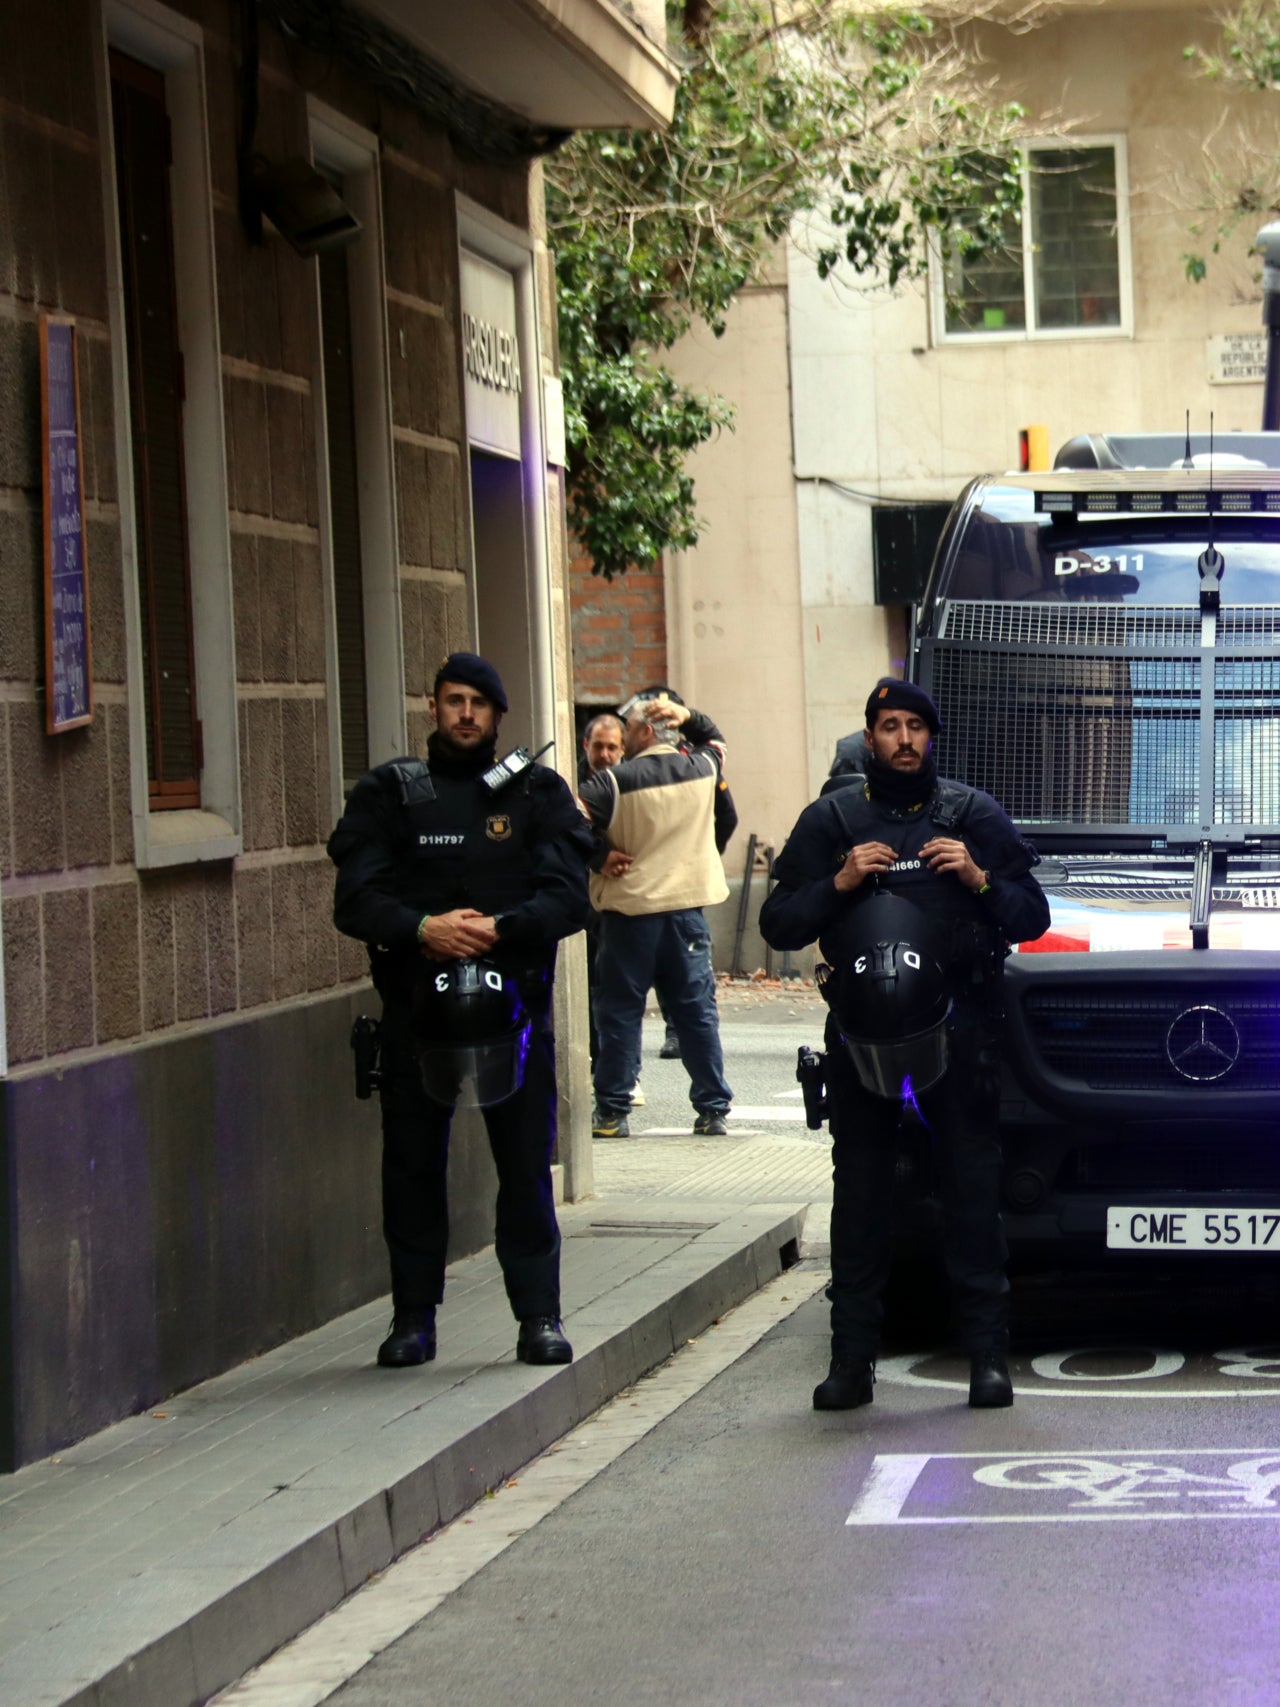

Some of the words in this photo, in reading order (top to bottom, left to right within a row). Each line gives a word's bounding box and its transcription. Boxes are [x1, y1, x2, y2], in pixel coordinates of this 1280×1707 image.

[1222, 366, 1266, 378] ARGENTIN
[1054, 554, 1144, 576] D-311
[419, 835, 465, 845] D1H797
[1129, 1213, 1188, 1244] CME
